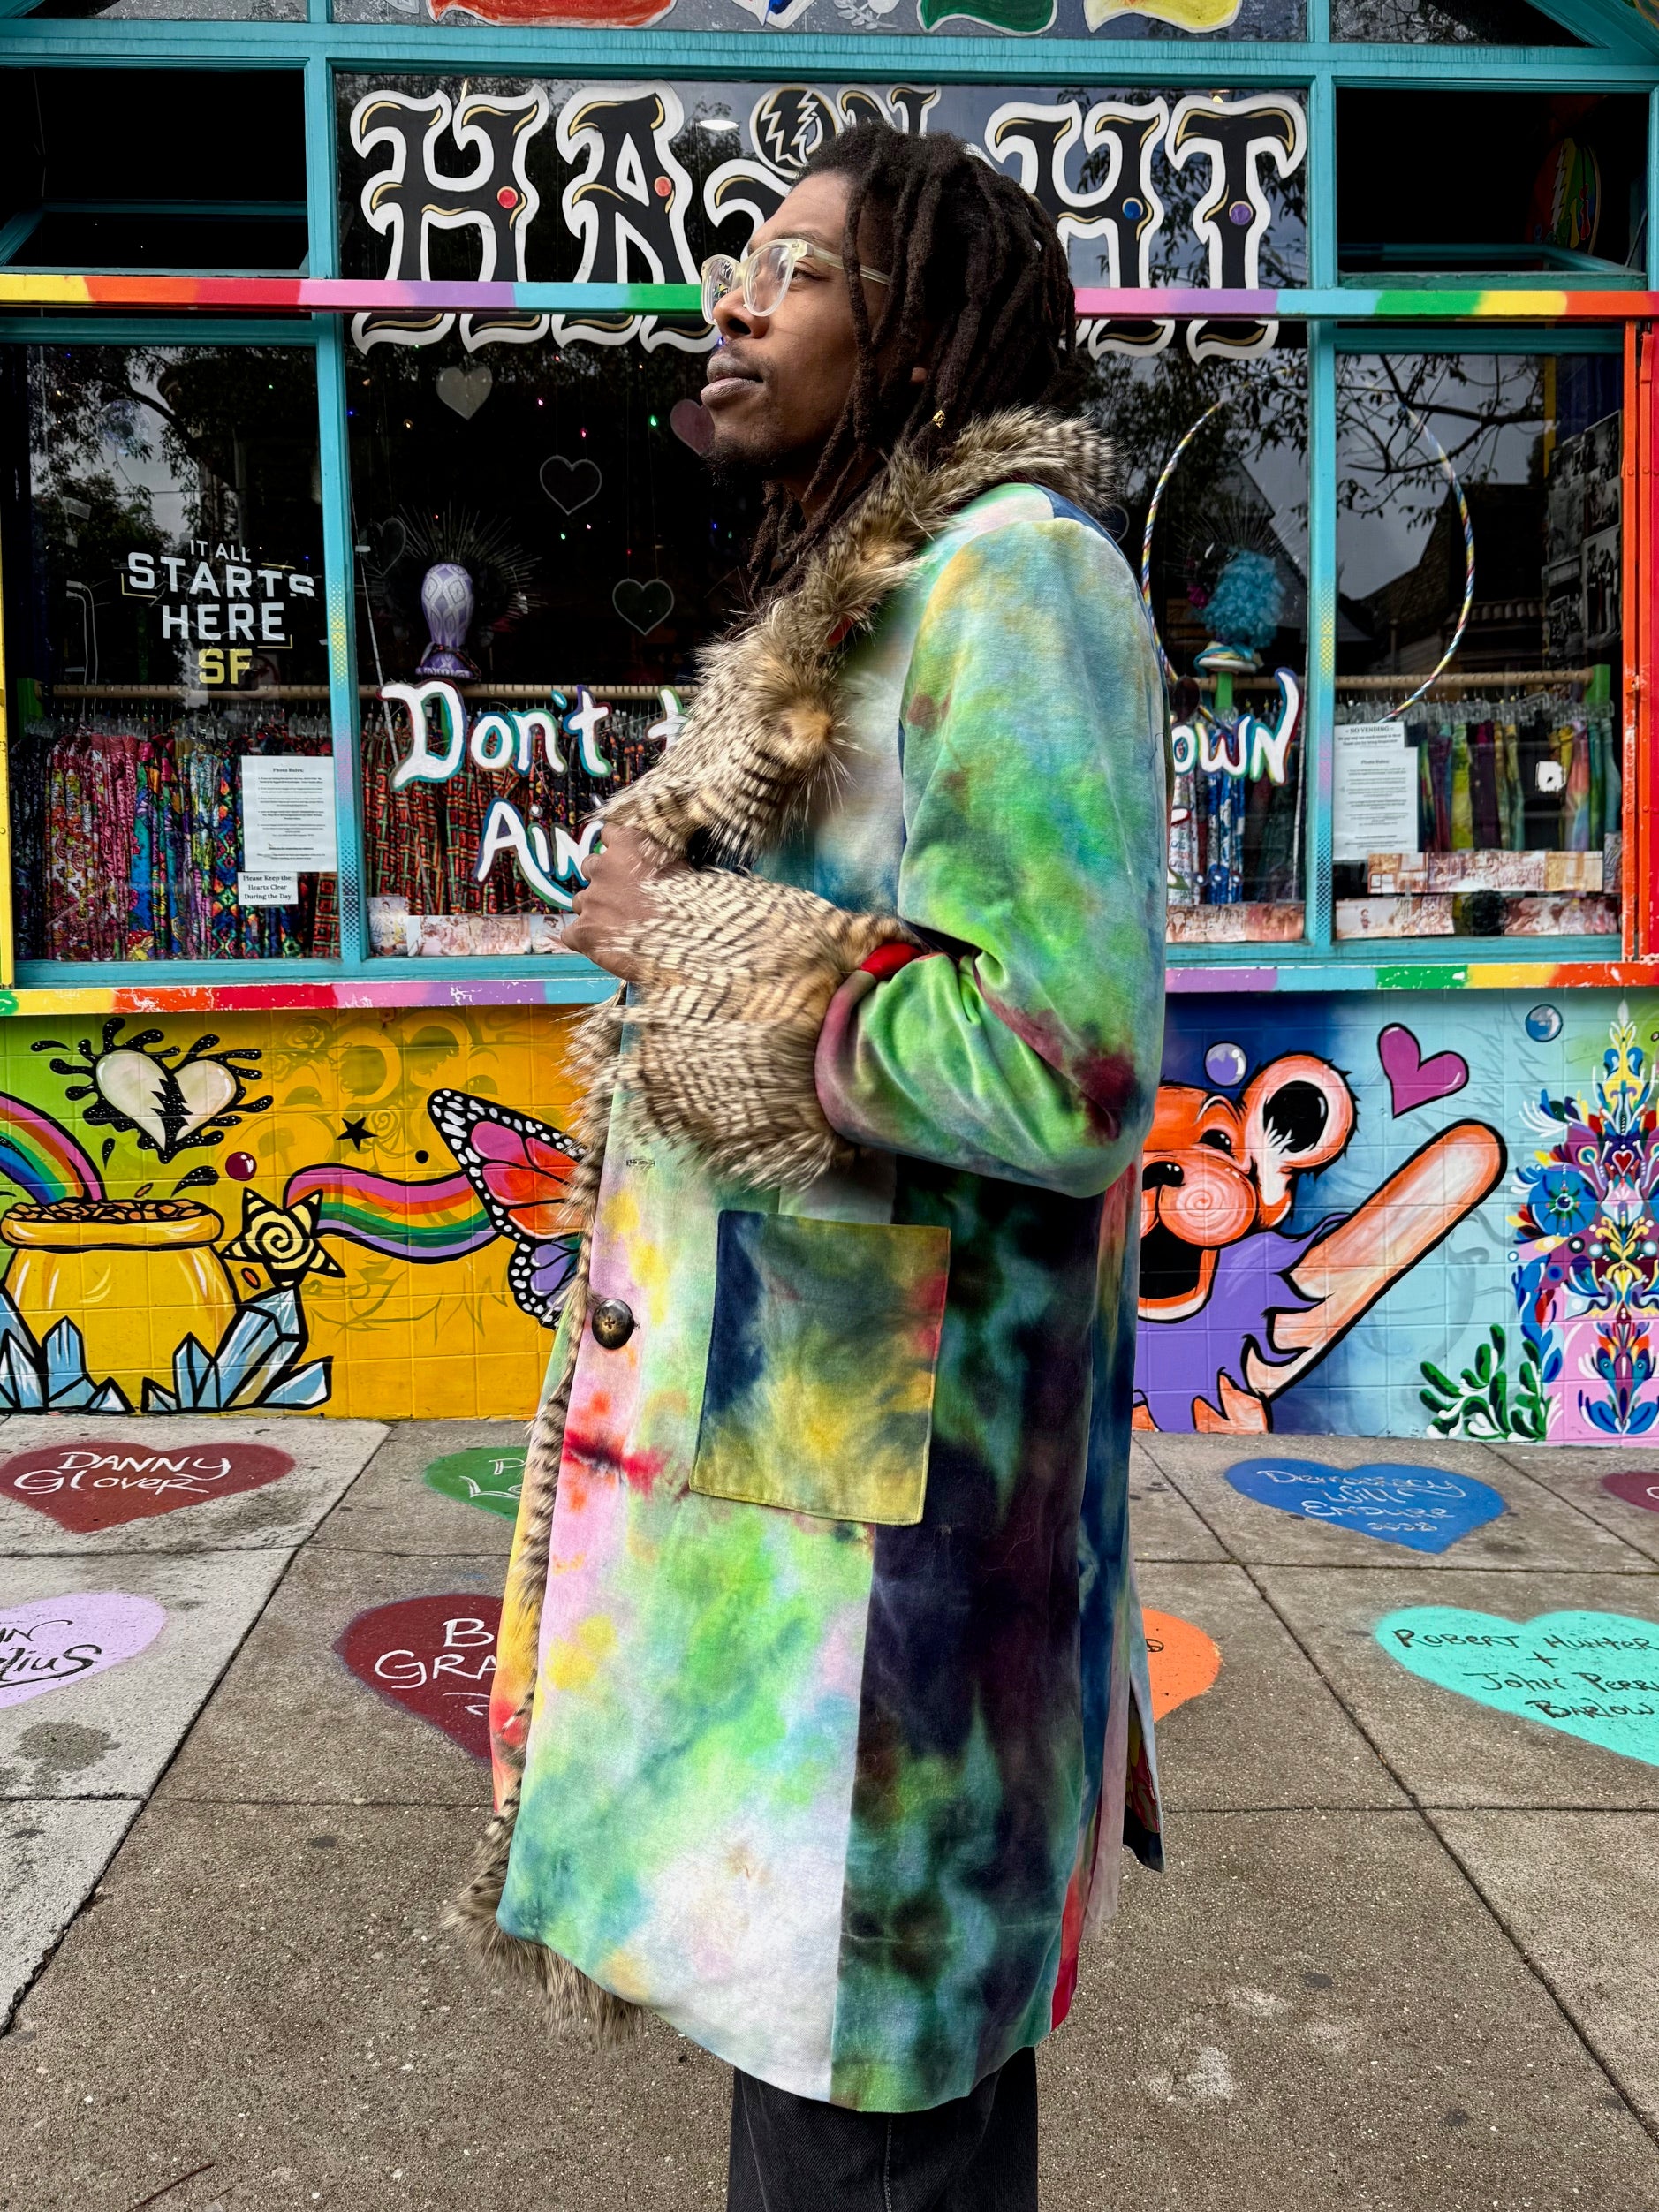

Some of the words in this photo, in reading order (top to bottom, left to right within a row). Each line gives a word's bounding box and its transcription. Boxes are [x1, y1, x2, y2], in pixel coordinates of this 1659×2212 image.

[350, 80, 1307, 364] HAHT
[190, 539, 208, 557] IT
[215, 542, 252, 564] ALL
[127, 551, 315, 598] STARTS
[162, 602, 286, 641] HERE
[198, 648, 254, 685] SF
